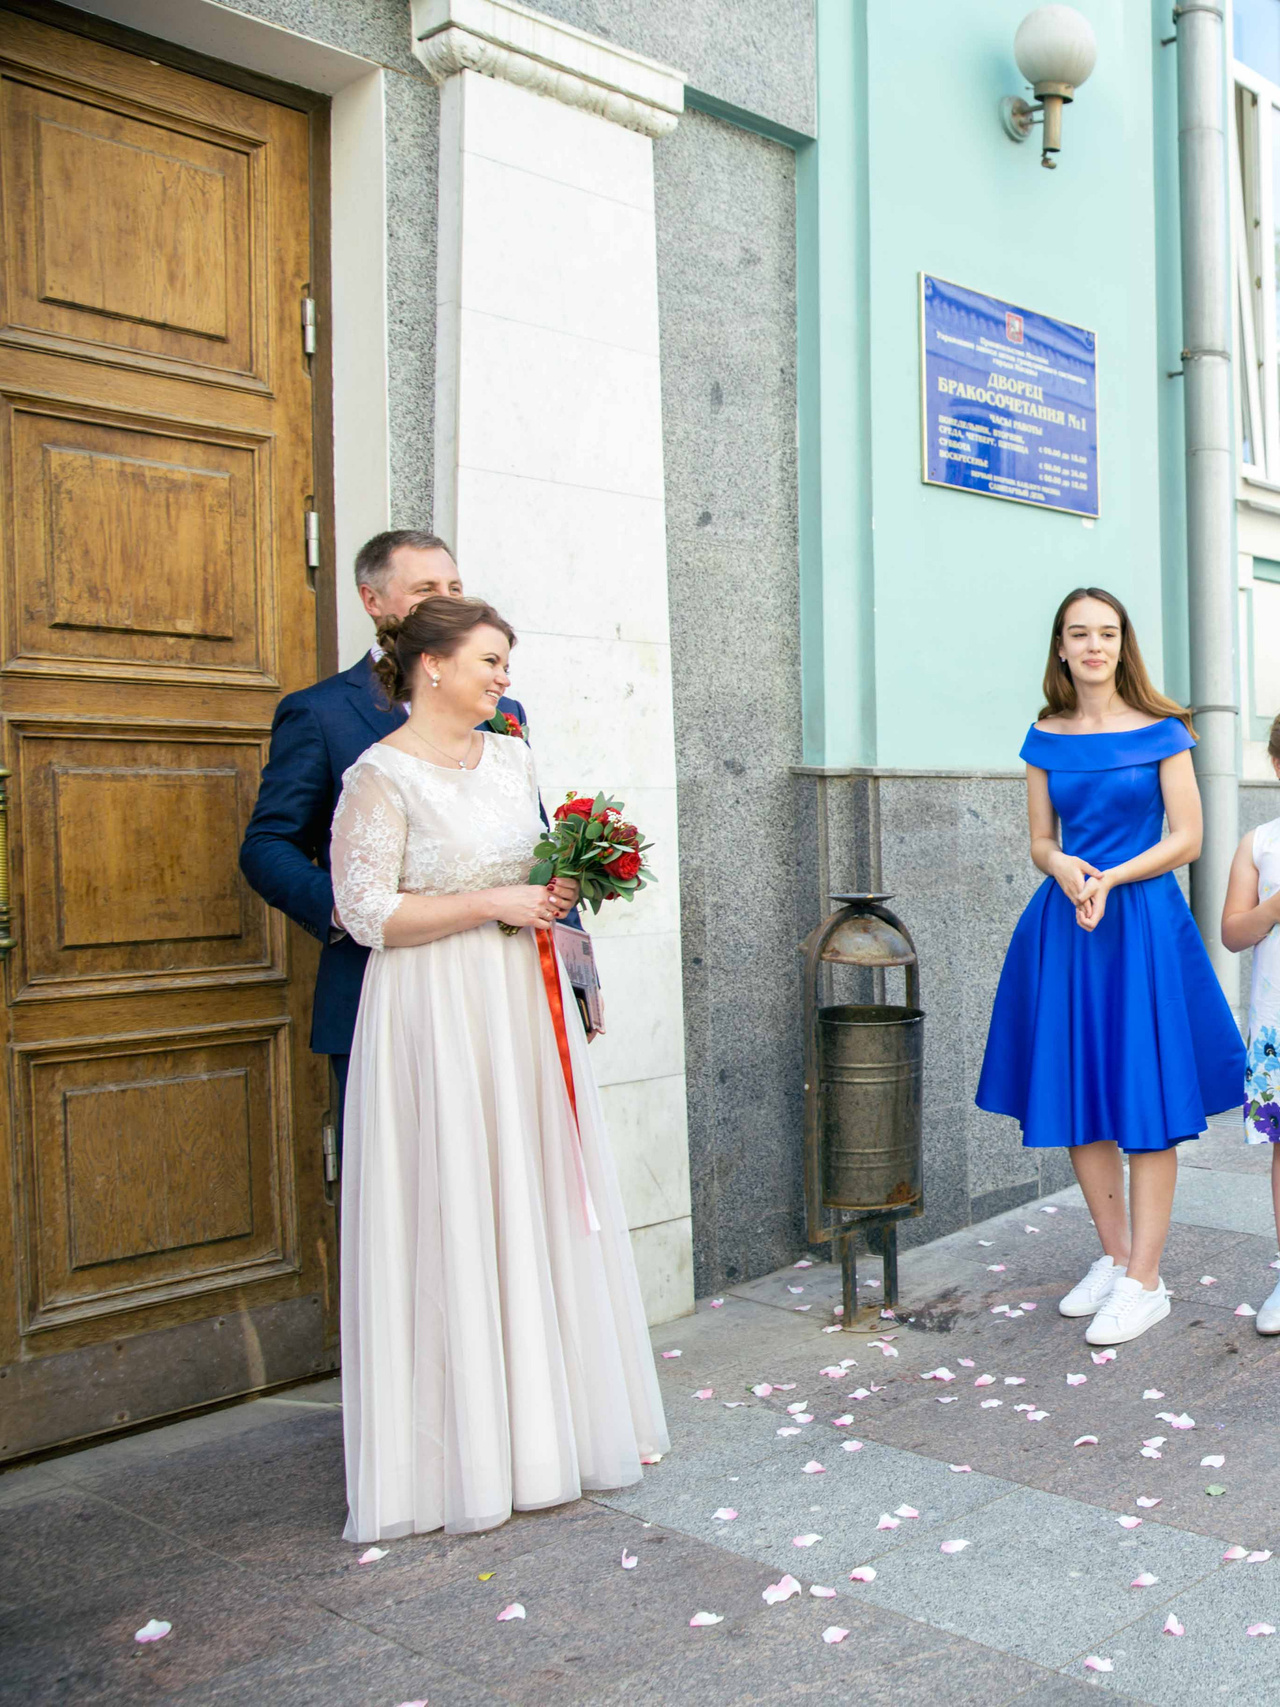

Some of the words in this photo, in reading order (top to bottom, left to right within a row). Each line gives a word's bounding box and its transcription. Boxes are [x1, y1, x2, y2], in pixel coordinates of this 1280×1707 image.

[937, 376, 1065, 426] БРАКОСОЧЕТАНИЯ
[1068, 413, 1087, 432] №1
[987, 372, 1044, 404] ДВОРЕЦ
[989, 413, 1012, 428] ЧАСЫ
[1013, 419, 1043, 436] РАБОТЫ
